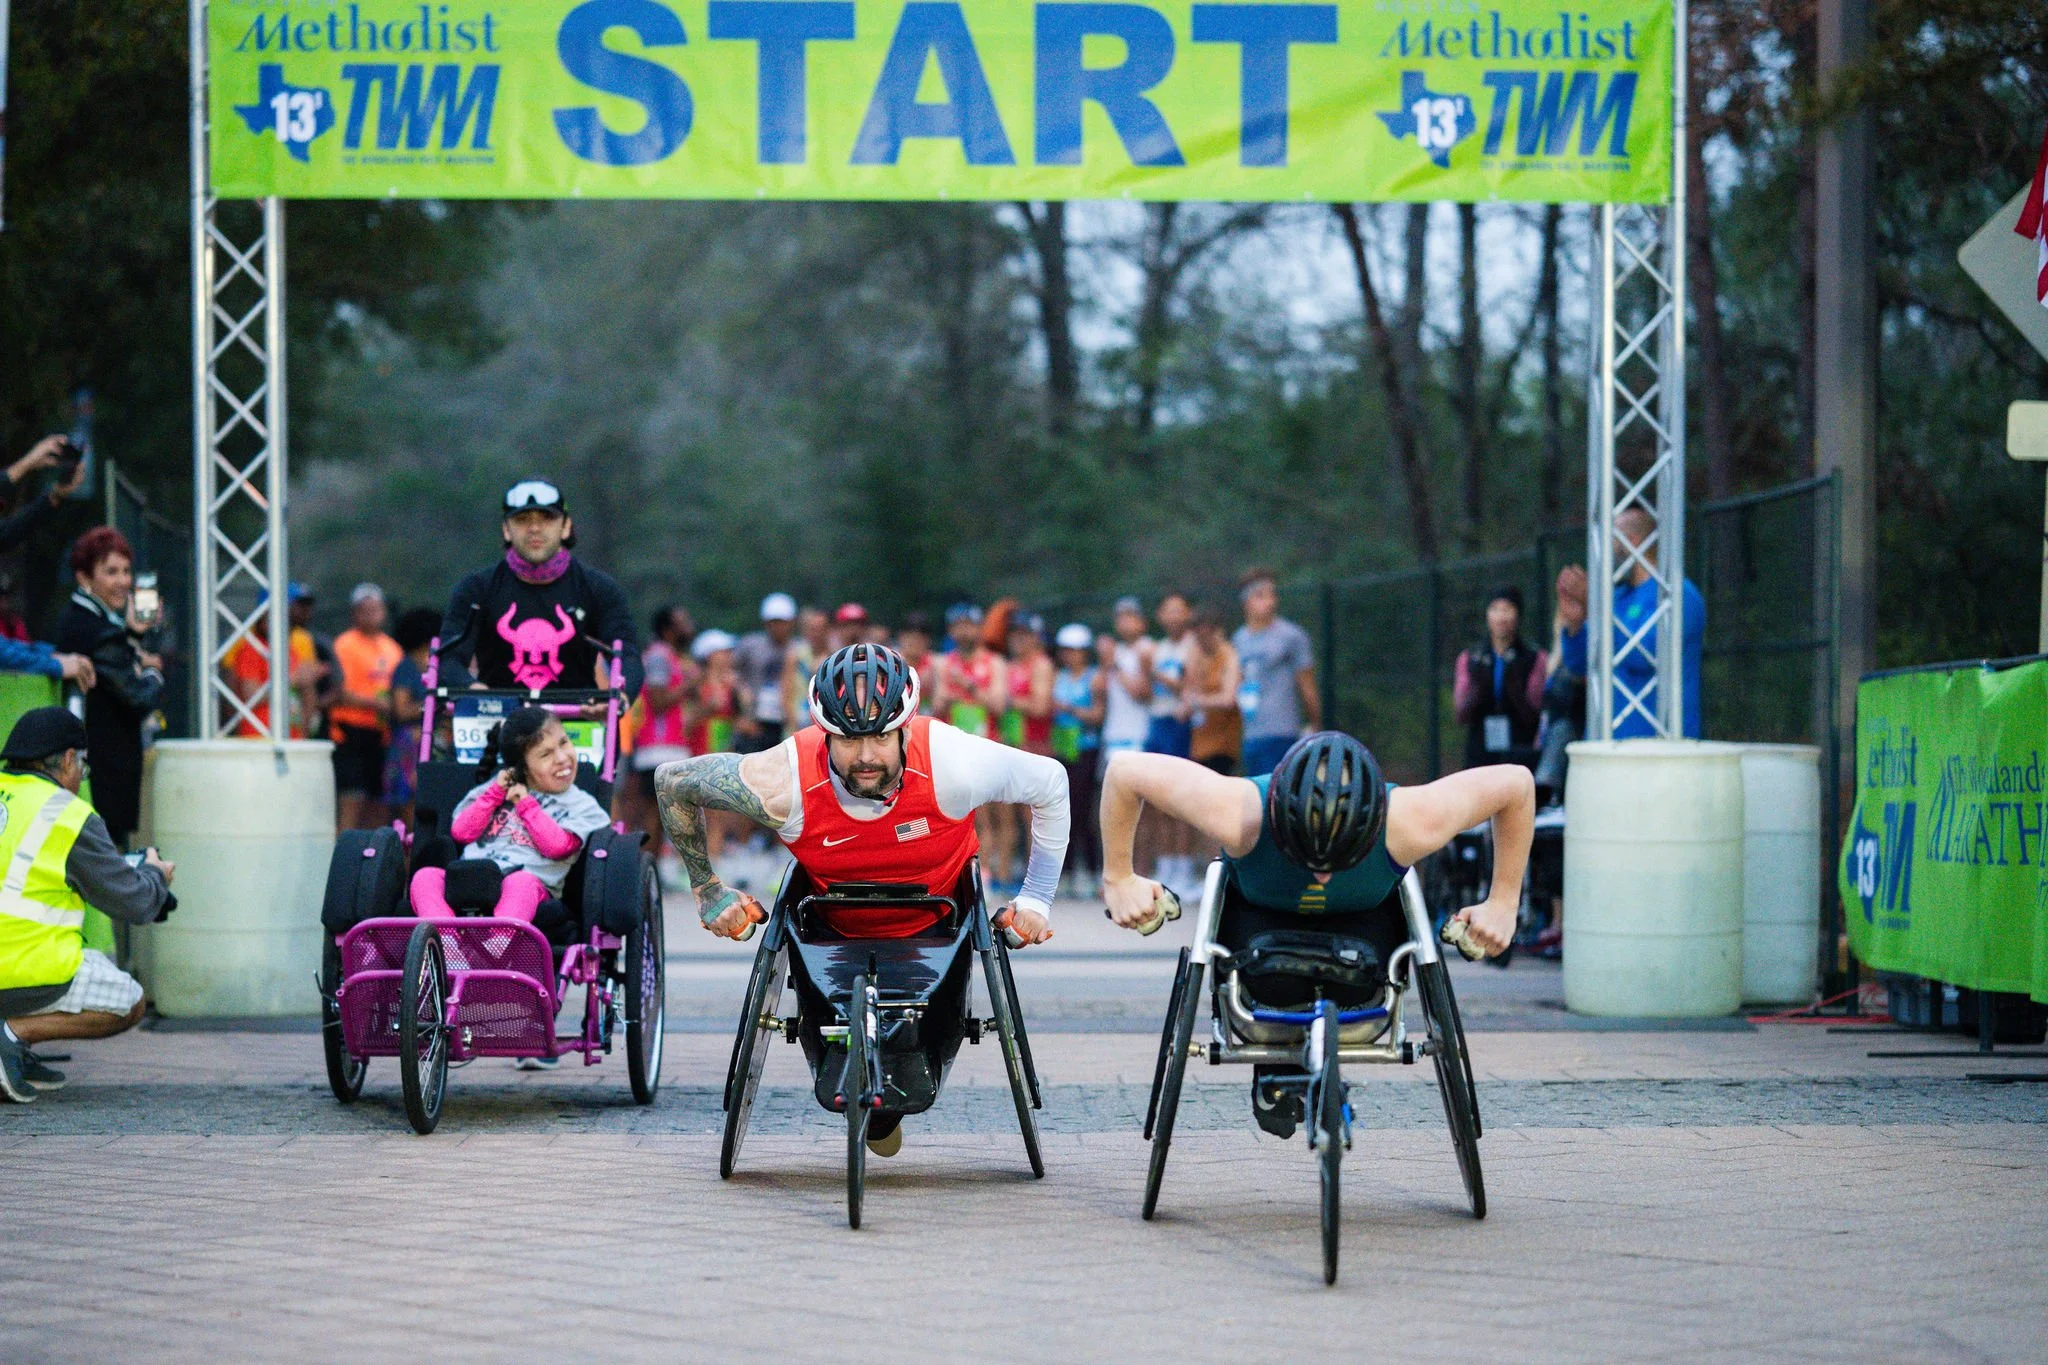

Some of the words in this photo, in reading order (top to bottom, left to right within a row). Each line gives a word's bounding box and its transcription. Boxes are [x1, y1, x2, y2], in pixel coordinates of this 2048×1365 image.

[232, 3, 501, 53] Methodist
[1379, 10, 1640, 60] Methodist
[340, 63, 502, 151] TWM
[551, 0, 1338, 168] START
[1482, 70, 1640, 159] TWM
[457, 728, 489, 743] 36
